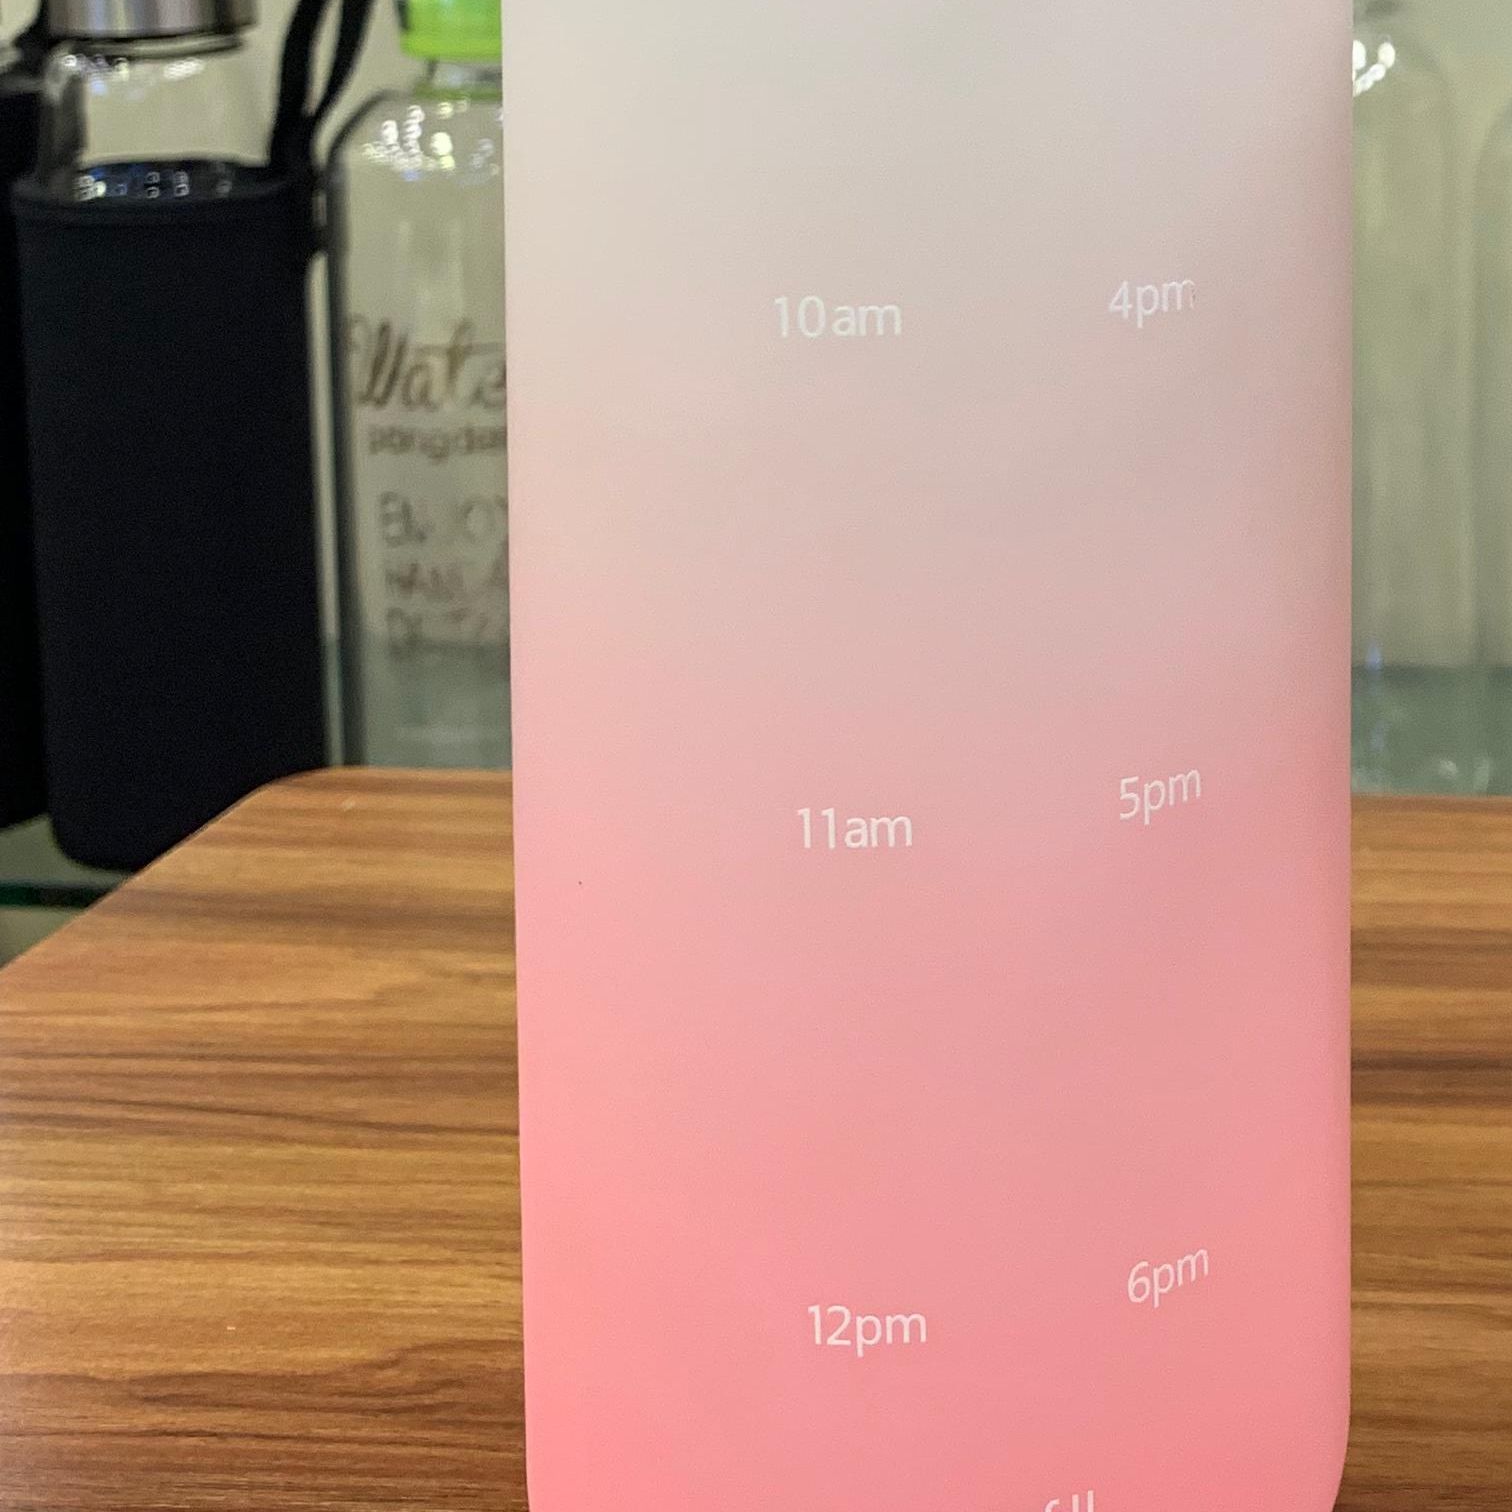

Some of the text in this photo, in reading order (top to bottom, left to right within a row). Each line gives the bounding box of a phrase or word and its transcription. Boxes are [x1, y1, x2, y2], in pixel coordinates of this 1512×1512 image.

[773, 295, 902, 339] 10am
[1108, 279, 1196, 328] 4pm
[1119, 768, 1202, 826] 5pm
[797, 807, 913, 849] 11am
[1127, 1248, 1210, 1308] 6pm
[808, 1304, 928, 1357] 12pm
